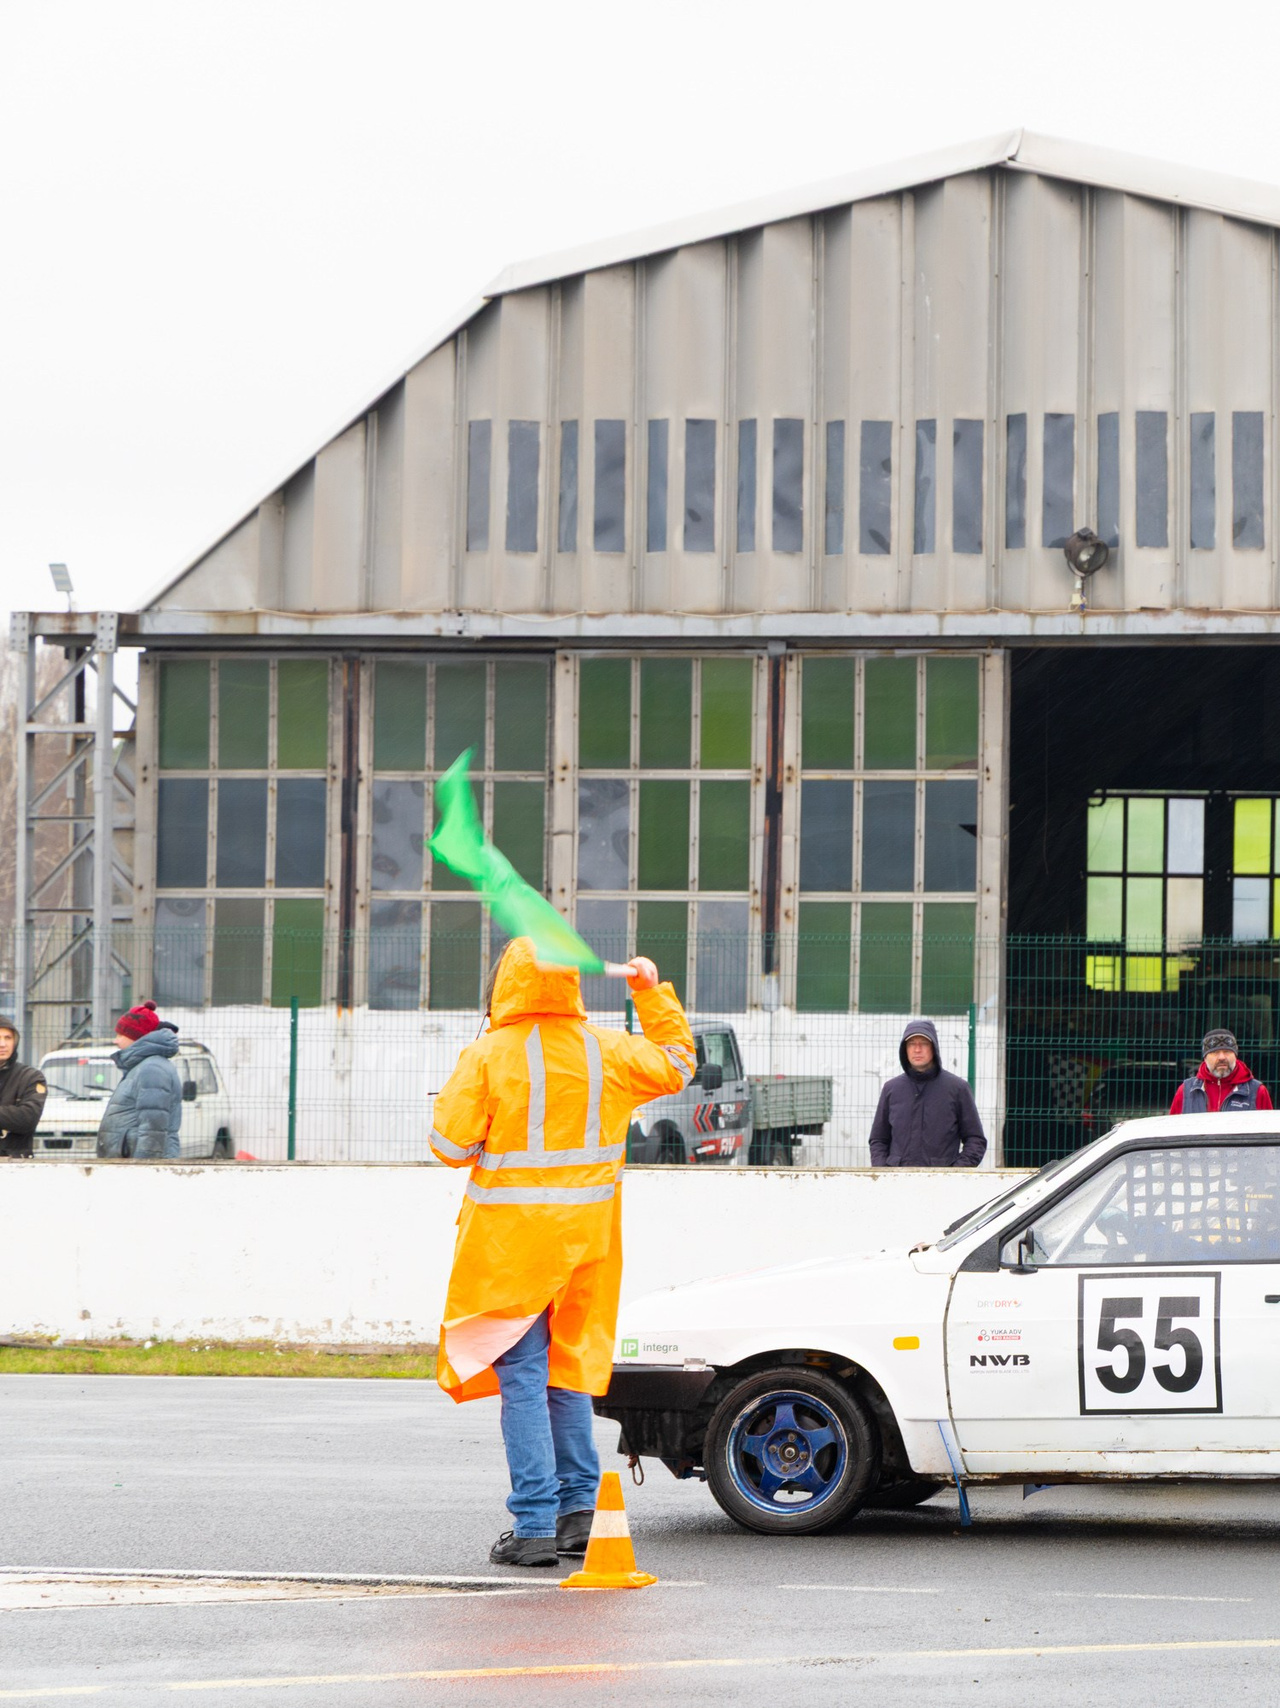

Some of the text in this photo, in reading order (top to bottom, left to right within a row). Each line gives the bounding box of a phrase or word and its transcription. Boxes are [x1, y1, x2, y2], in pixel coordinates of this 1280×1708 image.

[624, 1342, 679, 1354] IP integra
[1095, 1296, 1204, 1394] 55
[970, 1354, 1031, 1366] NWB
